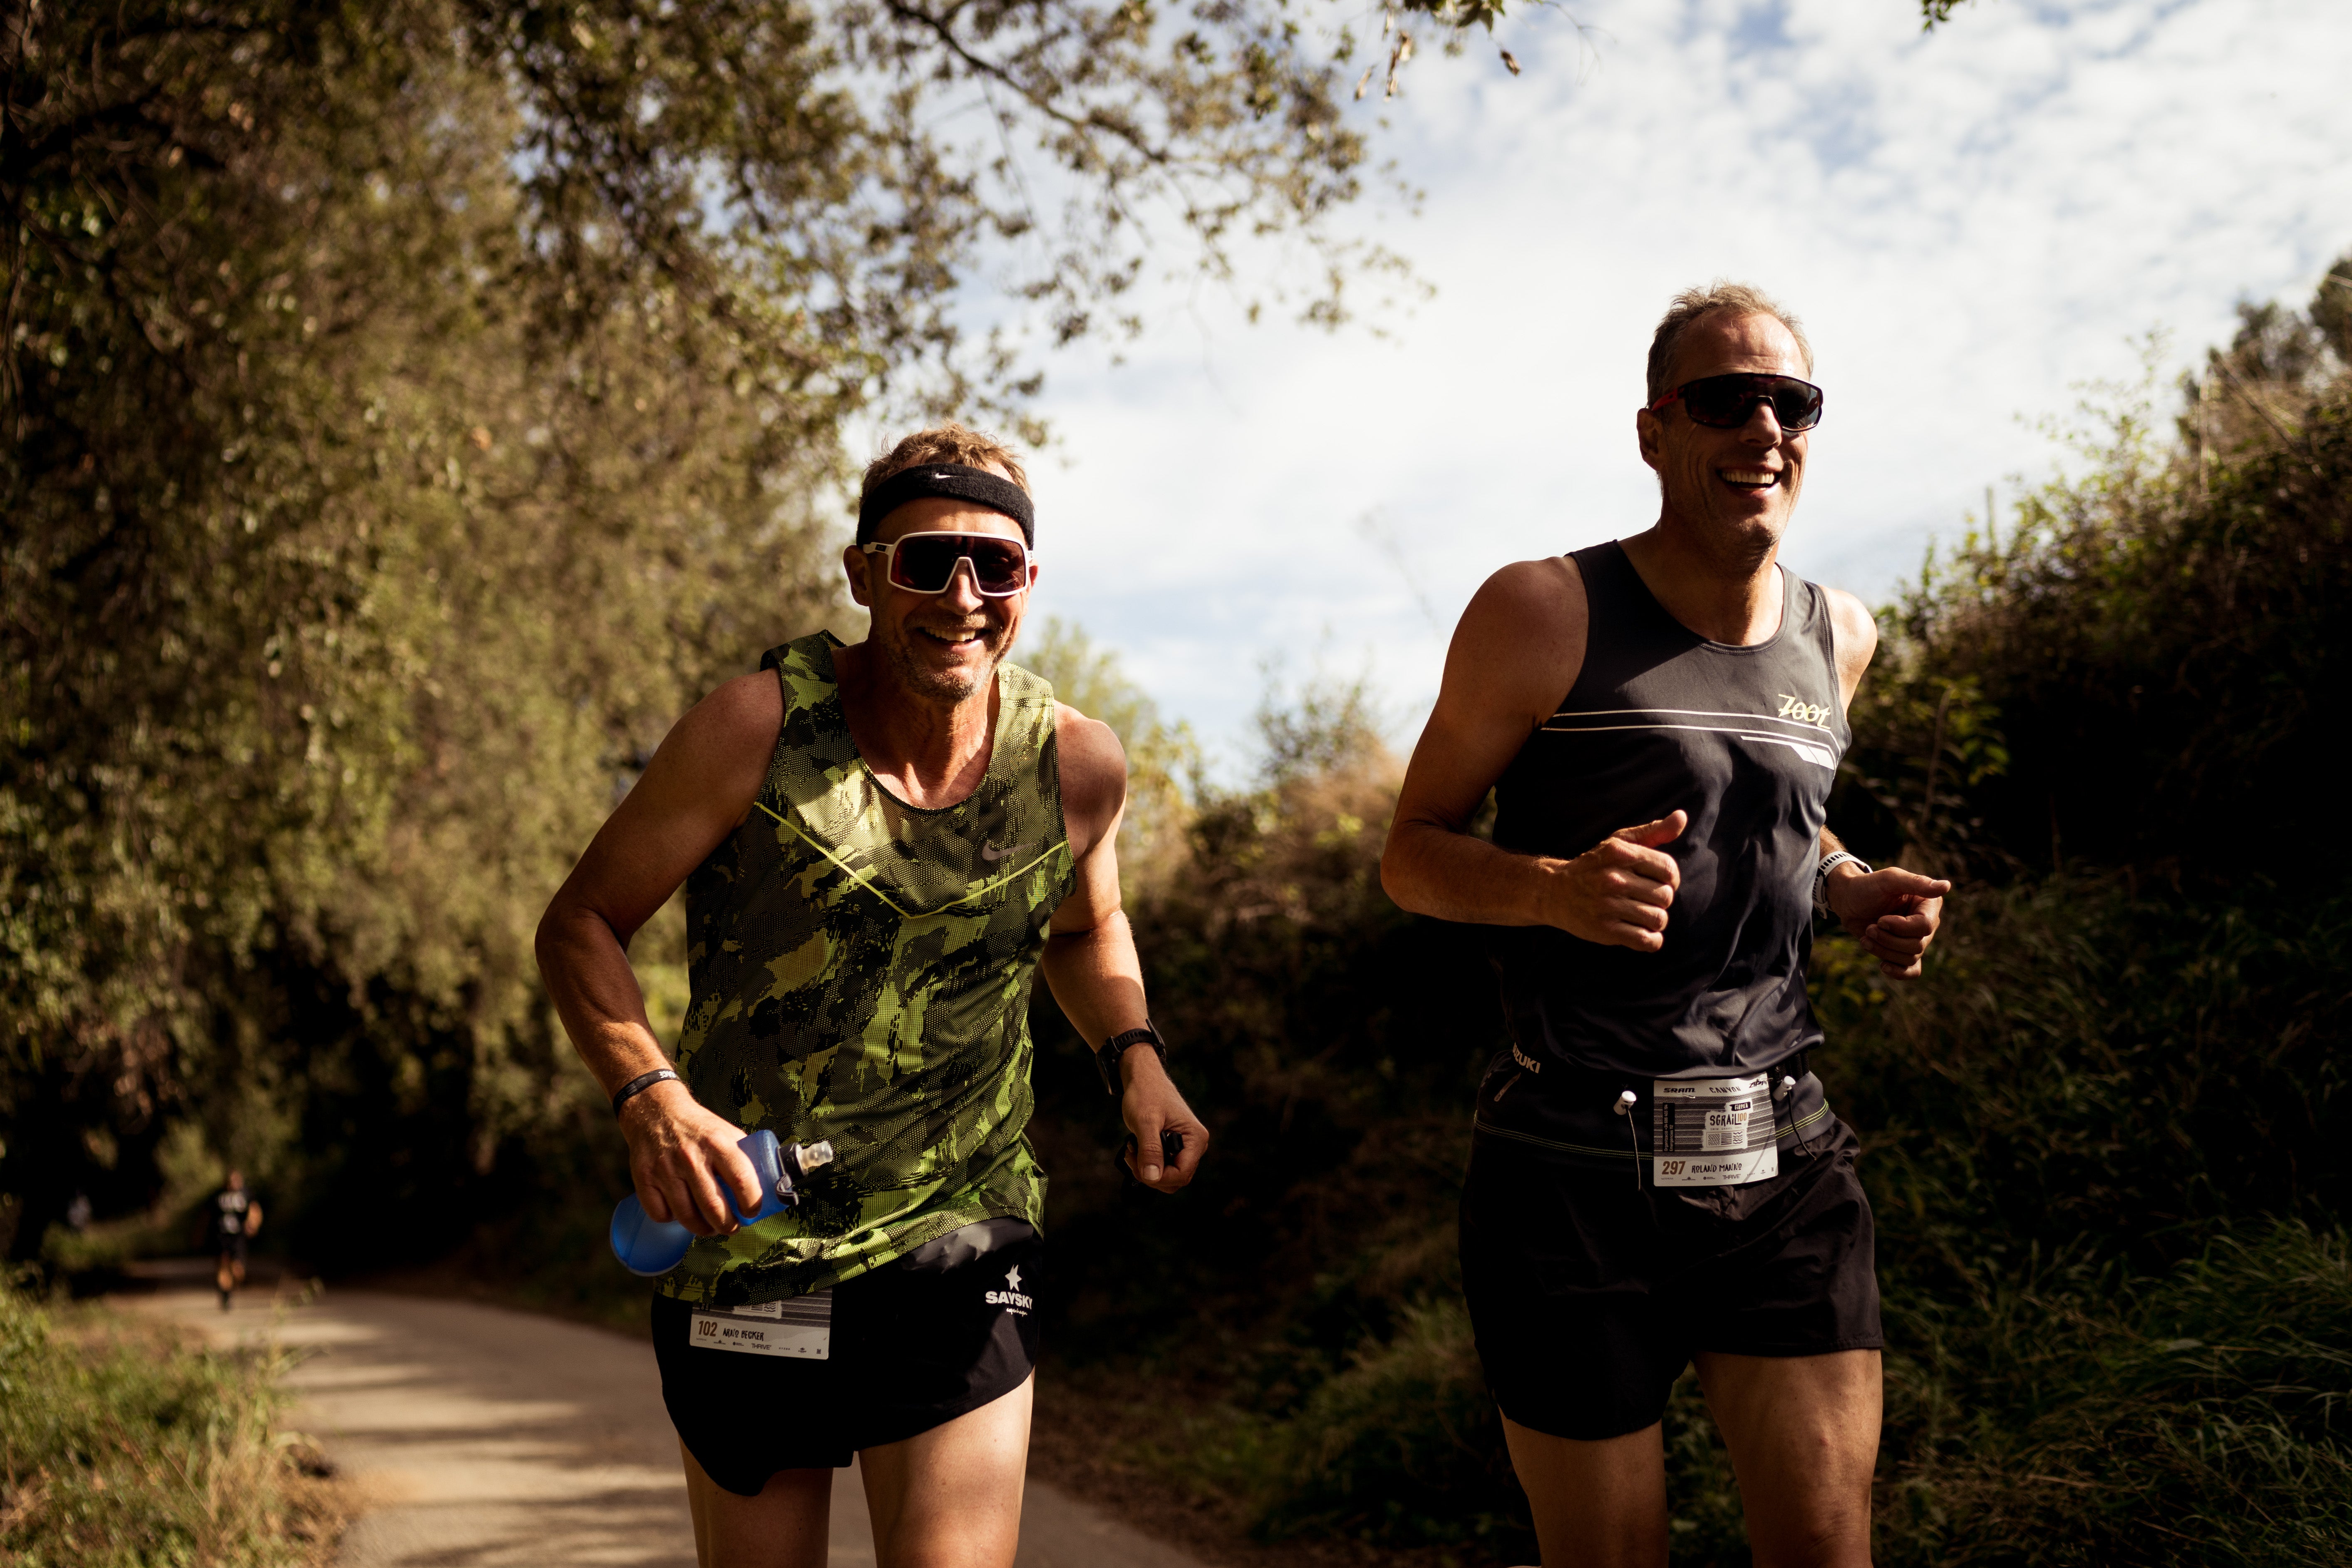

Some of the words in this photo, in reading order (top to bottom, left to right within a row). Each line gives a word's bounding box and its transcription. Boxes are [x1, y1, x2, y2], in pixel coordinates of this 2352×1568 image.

[1662, 1161, 1686, 1175] 297
[1692, 1164, 1717, 1174] ROLAND
[1719, 1163, 1742, 1172] MANNO
[985, 1291, 1032, 1310] SAYSKY
[698, 1320, 717, 1337] 102
[722, 1327, 739, 1338] ARNO
[741, 1330, 764, 1341] BECKER
